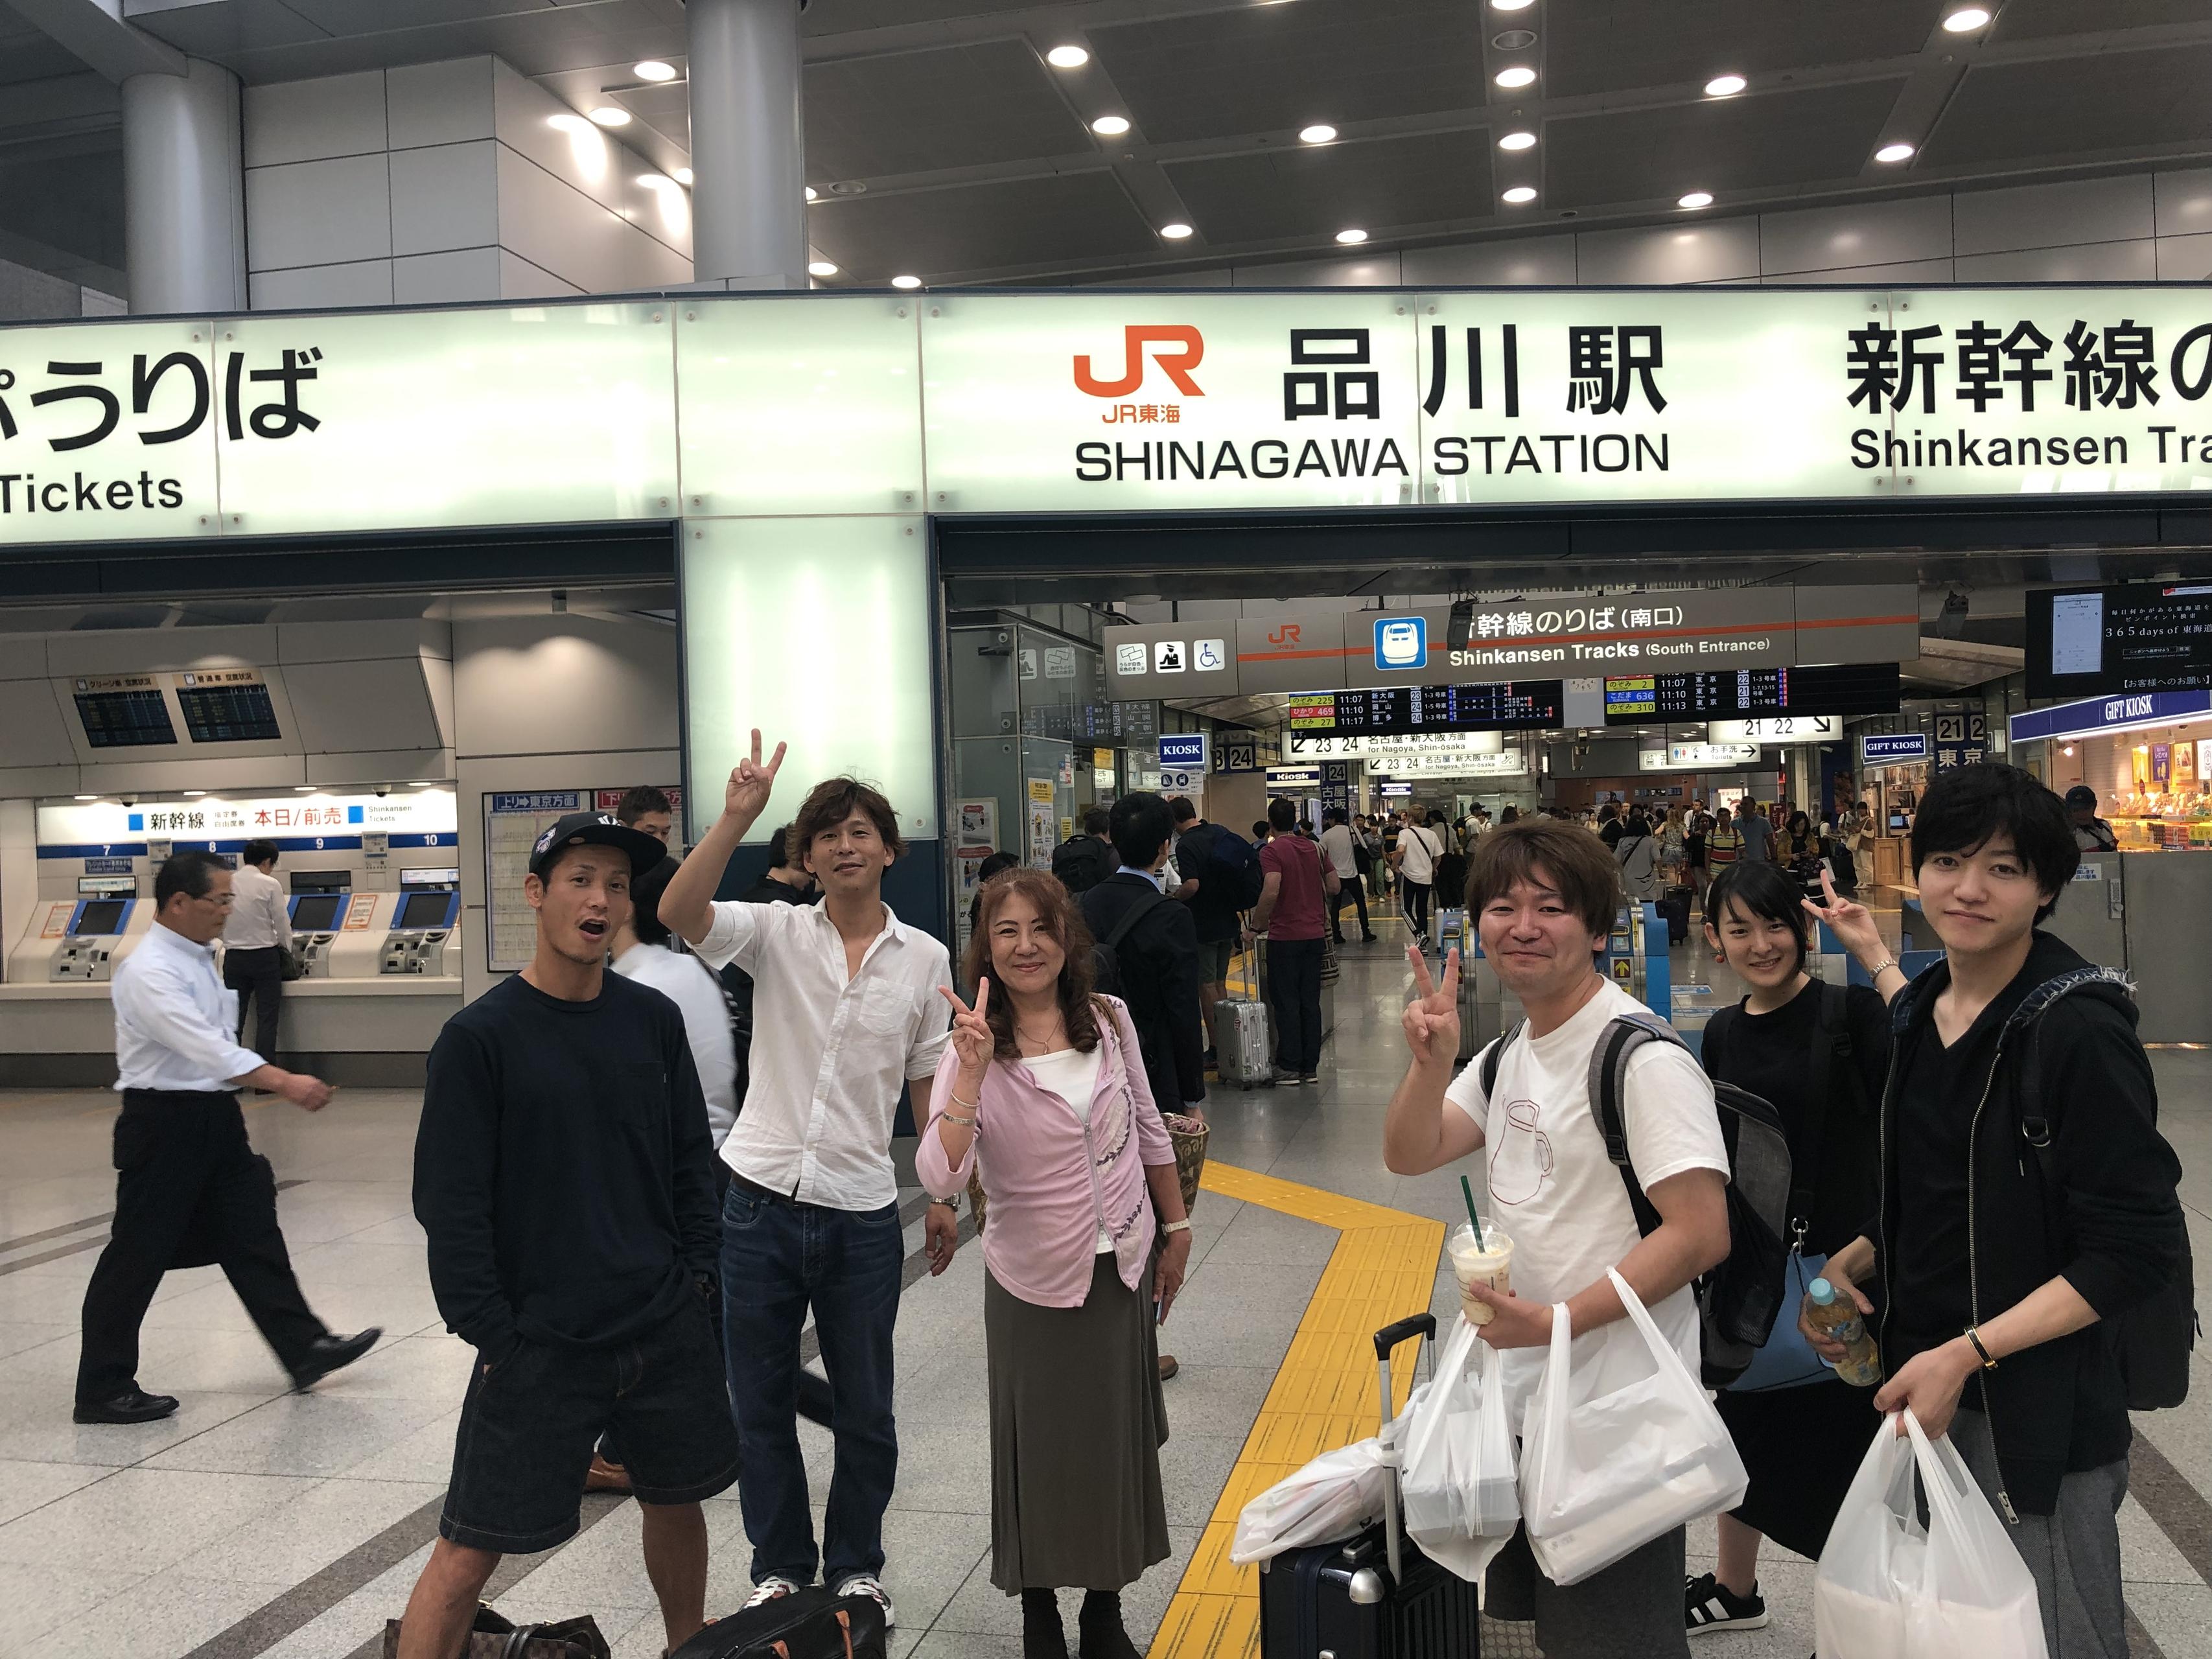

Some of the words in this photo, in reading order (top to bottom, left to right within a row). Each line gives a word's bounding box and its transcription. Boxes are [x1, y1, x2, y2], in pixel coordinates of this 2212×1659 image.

[1073, 325, 1205, 397] JR
[1283, 323, 1668, 421] 品川駅
[0, 347, 323, 452] うりば
[1102, 404, 1181, 424] JR東海
[1850, 428, 2128, 469] Shinkansen
[1075, 437, 1410, 481] SHINAGAWA
[1434, 433, 1670, 475] STATION
[1268, 625, 1301, 644] JR
[2139, 625, 2163, 638] days
[2167, 625, 2179, 634] of
[1449, 647, 1565, 667] Shinkansen
[1571, 642, 1640, 659] Tracks
[1646, 643, 1694, 656] (South
[1699, 638, 1770, 653] Entrance)
[1660, 679, 1685, 688] 11:07
[1695, 675, 1717, 684] 東京
[1738, 675, 1749, 684] 22
[1340, 695, 1362, 704] 11:07
[1412, 691, 1421, 700] 23
[1636, 691, 1653, 701] 636
[1661, 690, 1686, 699] 11:10
[1695, 687, 1717, 695] 東京
[1739, 687, 1748, 695] 21
[1317, 707, 1333, 715] 469
[1340, 706, 1363, 715] 11:10
[1412, 702, 1421, 711] 24
[1661, 701, 1686, 710] 11:13
[1695, 698, 1717, 706] 東京
[1739, 698, 1749, 707] 22
[2105, 699, 2125, 721] GIFT
[2126, 694, 2153, 717] KIOSK
[1341, 717, 1364, 725] 11:17
[1412, 713, 1421, 722] 24
[1745, 719, 1761, 736] 21
[1775, 718, 1793, 734] 22
[1939, 719, 1961, 739] 21
[1163, 745, 1200, 755] KIOSK
[1314, 738, 1332, 752] 23
[1342, 737, 1359, 752] 24
[1382, 745, 1416, 754] Nagoya,
[1710, 745, 1738, 754] お手洗
[1867, 743, 1890, 751] GIFT
[1892, 741, 1922, 750] KIOSK
[1231, 748, 1252, 767] 24
[1387, 758, 1399, 769] 23
[1406, 758, 1419, 769] 24
[1937, 747, 1984, 768] 東京
[1330, 766, 1344, 779] 24
[1321, 785, 1346, 798] 古屋
[501, 795, 520, 809] 上り
[530, 795, 575, 807] 東京方面
[1321, 798, 1347, 811] 大阪
[150, 811, 205, 831] 新幹線
[255, 807, 342, 827] 本日/前売
[316, 838, 323, 849] 9
[423, 834, 437, 846] 10
[103, 844, 111, 856] 7
[209, 841, 216, 853] 8
